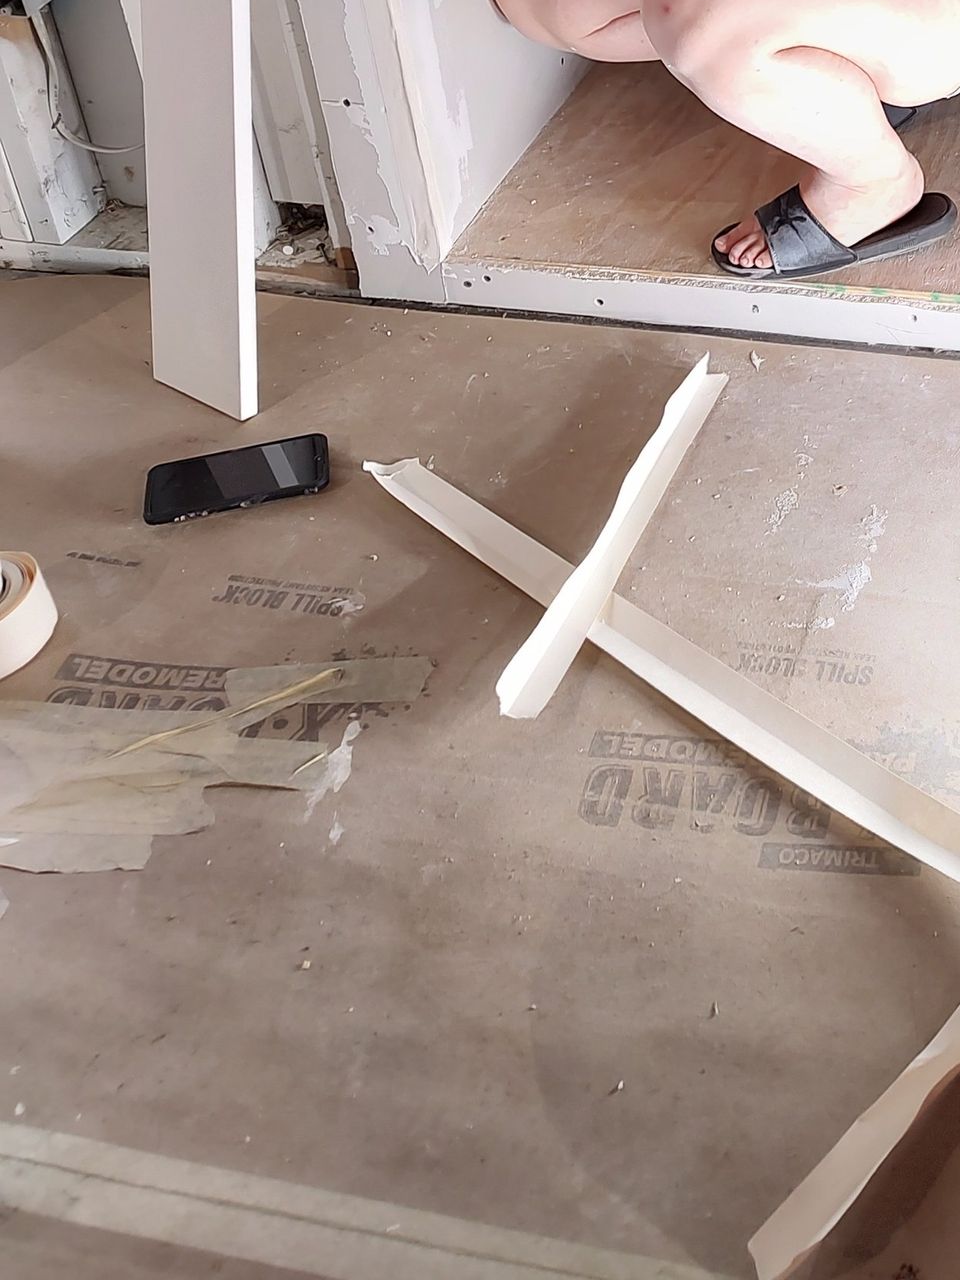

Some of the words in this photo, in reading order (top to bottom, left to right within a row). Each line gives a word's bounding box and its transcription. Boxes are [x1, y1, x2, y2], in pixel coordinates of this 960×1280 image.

[70, 656, 228, 690] REMODEL
[815, 660, 874, 685] SPILL
[778, 845, 881, 870] TRIMACO
